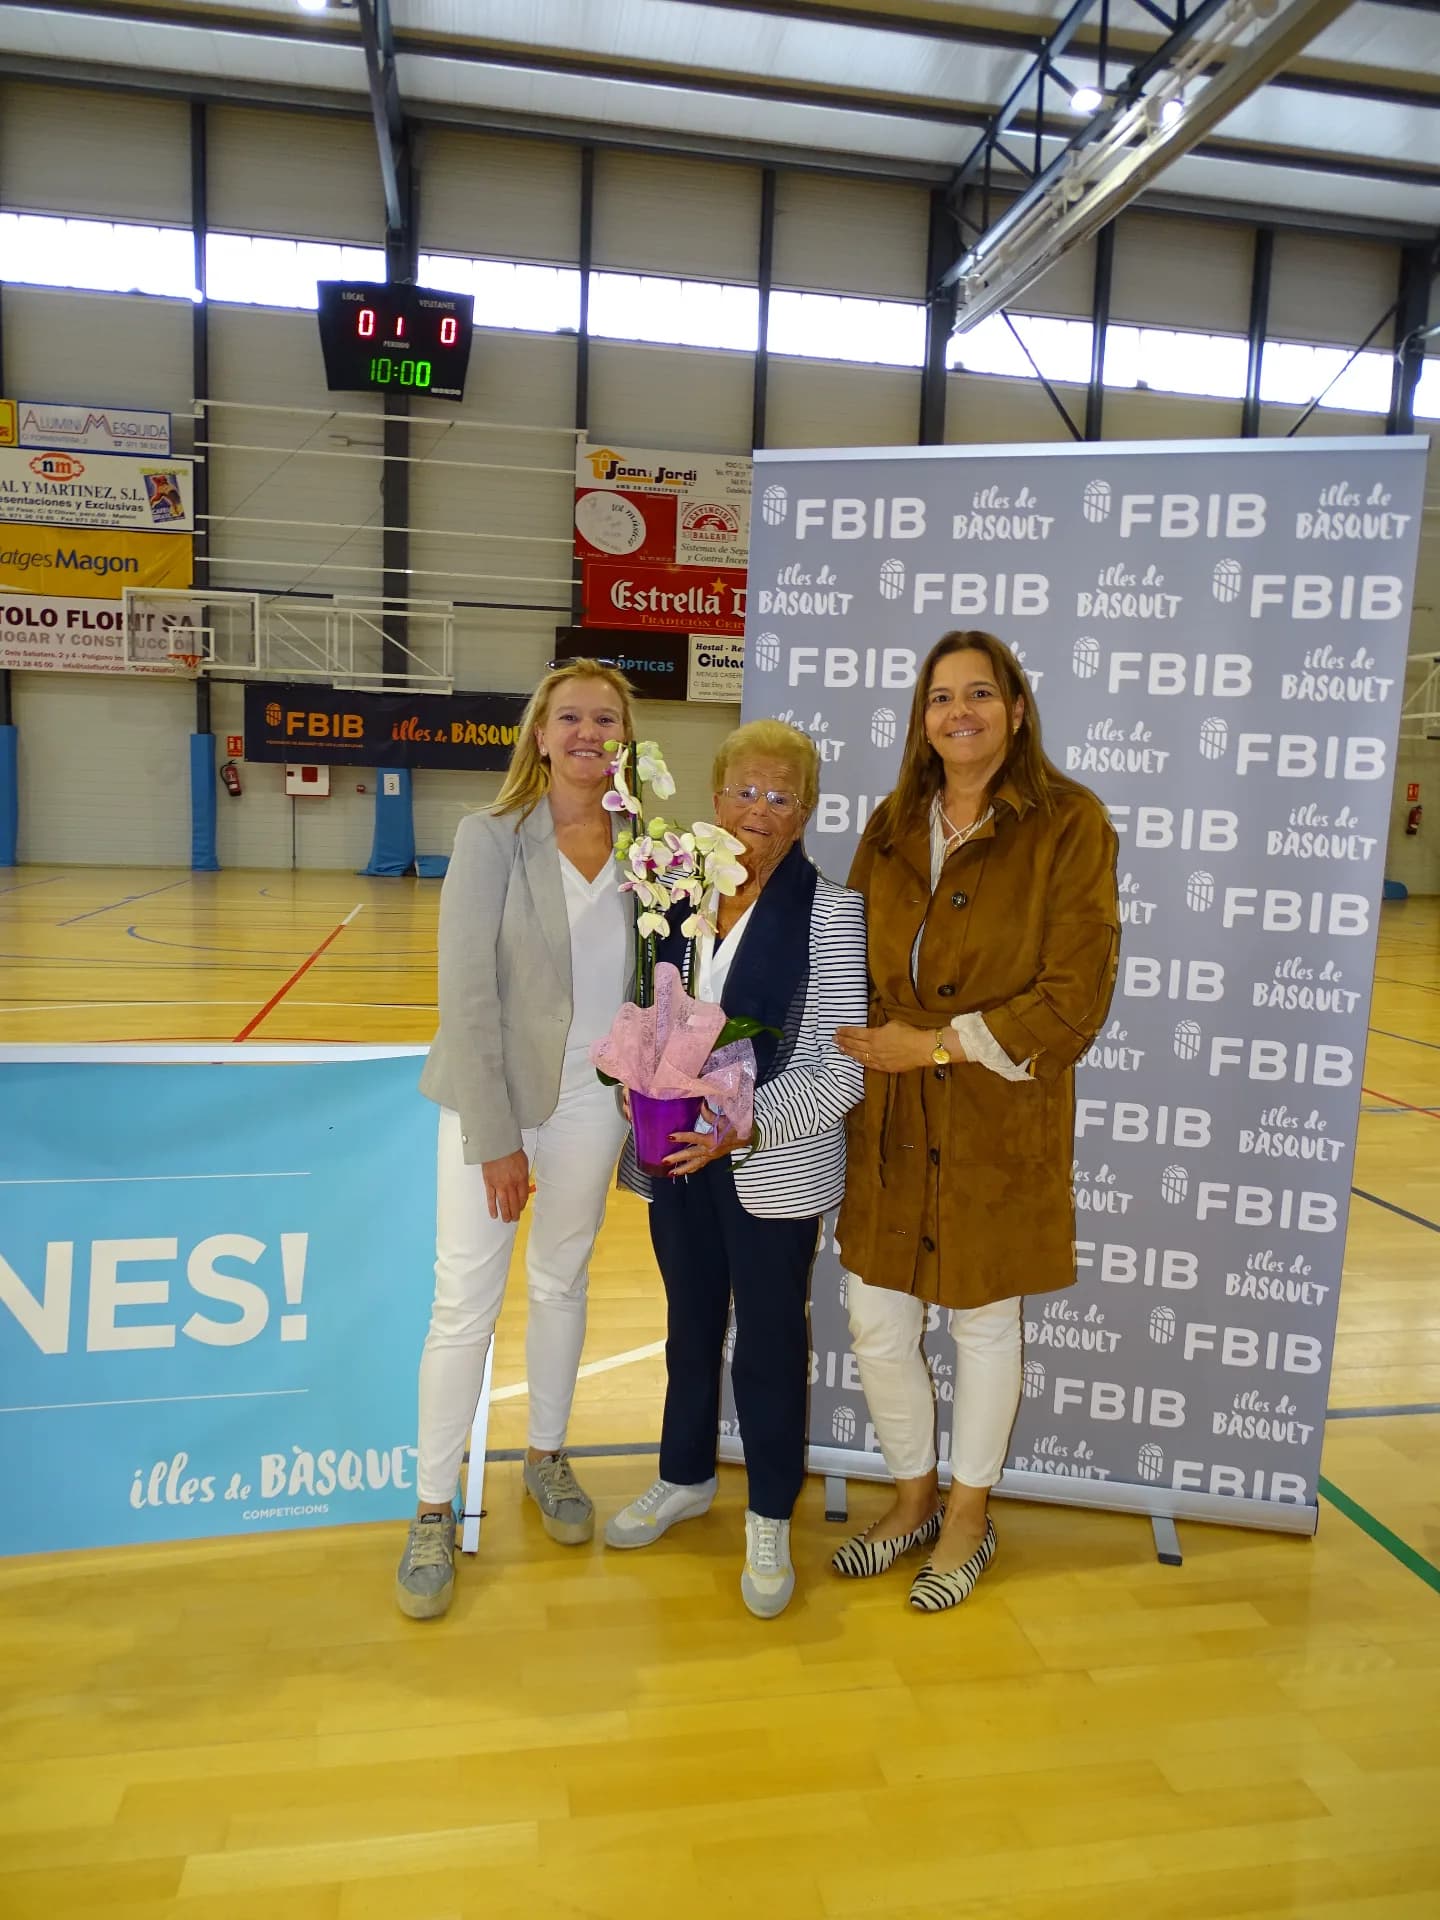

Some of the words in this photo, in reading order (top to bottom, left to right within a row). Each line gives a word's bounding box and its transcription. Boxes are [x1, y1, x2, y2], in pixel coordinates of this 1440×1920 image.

[358, 310, 374, 336] 0
[397, 317, 403, 336] 1
[440, 318, 456, 344] 0
[370, 358, 431, 387] 10:00
[42, 459, 72, 474] nm
[605, 460, 647, 480] Joan
[654, 467, 696, 484] Jordi
[22, 482, 32, 493] Y
[35, 482, 117, 500] MARTINEZ,
[120, 489, 145, 501] S.L.
[973, 486, 1008, 509] illes
[1015, 487, 1036, 508] de
[1319, 482, 1360, 506] illes
[1367, 483, 1391, 506] de
[75, 501, 82, 511] y
[85, 501, 144, 513] Exclusivas
[796, 498, 926, 539] FBIB
[1120, 494, 1266, 537] FBIB
[692, 532, 727, 541] BALEAR
[953, 512, 1054, 540] BÀSQUET
[1296, 509, 1411, 540] BÀSQUET
[681, 543, 717, 554] Sistemas
[719, 546, 728, 554] de
[694, 554, 724, 564] Contra
[55, 548, 139, 576] Magon
[777, 563, 811, 585] illes
[816, 565, 836, 585] de
[1098, 563, 1136, 586] illes
[1142, 565, 1164, 586] de
[610, 580, 721, 615] Estrella
[759, 588, 853, 615] BÀSQUET
[914, 574, 1049, 615] FBIB
[1077, 589, 1182, 619] BÀSQUET
[1251, 575, 1402, 619] FBIB
[640, 614, 710, 627] TRADICIÓN
[56, 632, 67, 644] Y
[695, 643, 723, 652] Hostal
[786, 645, 916, 690] FBIB
[1304, 645, 1343, 669] illes
[1351, 647, 1374, 669] de
[1109, 652, 1252, 696] FBIB
[1282, 671, 1394, 702] BÀSQUET
[287, 712, 364, 739] FBIB
[392, 716, 430, 741] illes
[811, 712, 829, 733] de
[1087, 718, 1124, 741] illes
[1130, 721, 1151, 742] de
[1066, 743, 1169, 773] BÀSQUET
[1236, 734, 1386, 780] FBIB
[387, 782, 395, 791] 3
[1289, 803, 1328, 826] illes
[1335, 806, 1358, 828] de
[1267, 828, 1377, 860] BÀSQUET
[1119, 872, 1140, 894] de
[1223, 888, 1369, 935] FBIB
[1113, 956, 1225, 1002] BIB
[1275, 957, 1313, 980] illes
[1319, 960, 1342, 982] de
[1253, 980, 1361, 1013] BÀSQUET
[1106, 1020, 1129, 1042] de
[1210, 1037, 1353, 1086] FBIB
[1075, 1099, 1212, 1148] FBIB
[1261, 1106, 1298, 1128] illes
[1304, 1110, 1326, 1131] de
[1239, 1128, 1345, 1162] BÀSQUET
[1094, 1163, 1117, 1185] de
[1197, 1182, 1337, 1232] FBIB
[1247, 1250, 1284, 1272] illes
[1290, 1255, 1311, 1275] de
[1226, 1271, 1329, 1305] BÀSQUET
[1044, 1300, 1078, 1320] illes
[1083, 1304, 1104, 1324] de
[1024, 1319, 1124, 1355] BÀSQUET
[1184, 1323, 1322, 1374] FBIB
[1054, 1378, 1185, 1427] FBIB
[1234, 1390, 1269, 1411] illes
[1276, 1395, 1296, 1415] de
[1213, 1411, 1314, 1445] BÀSQUET
[1034, 1436, 1068, 1455] illes
[1073, 1440, 1093, 1460] de
[129, 1452, 216, 1510] illes
[224, 1472, 252, 1501] de
[260, 1444, 418, 1498] BÀSQUE
[242, 1504, 329, 1520] COMPETICIONS
